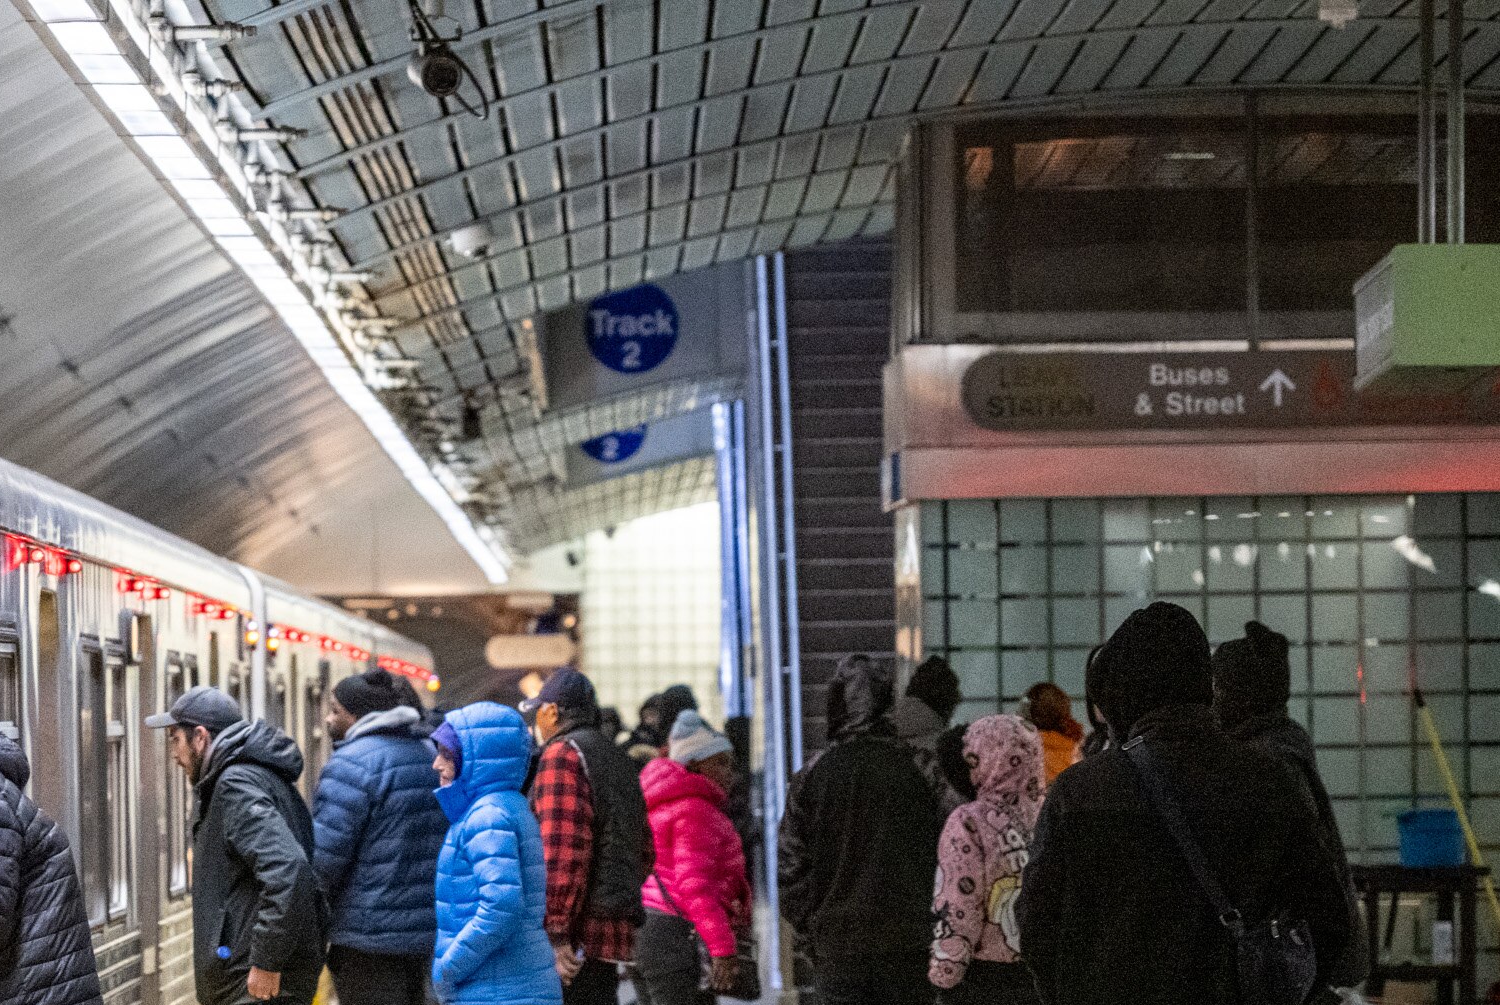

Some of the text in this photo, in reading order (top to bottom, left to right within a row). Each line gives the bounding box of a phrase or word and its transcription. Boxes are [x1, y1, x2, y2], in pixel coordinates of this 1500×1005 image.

[589, 308, 674, 339] Track
[621, 340, 642, 369] 2
[1150, 363, 1229, 386] Buses
[1134, 391, 1246, 415] & Street
